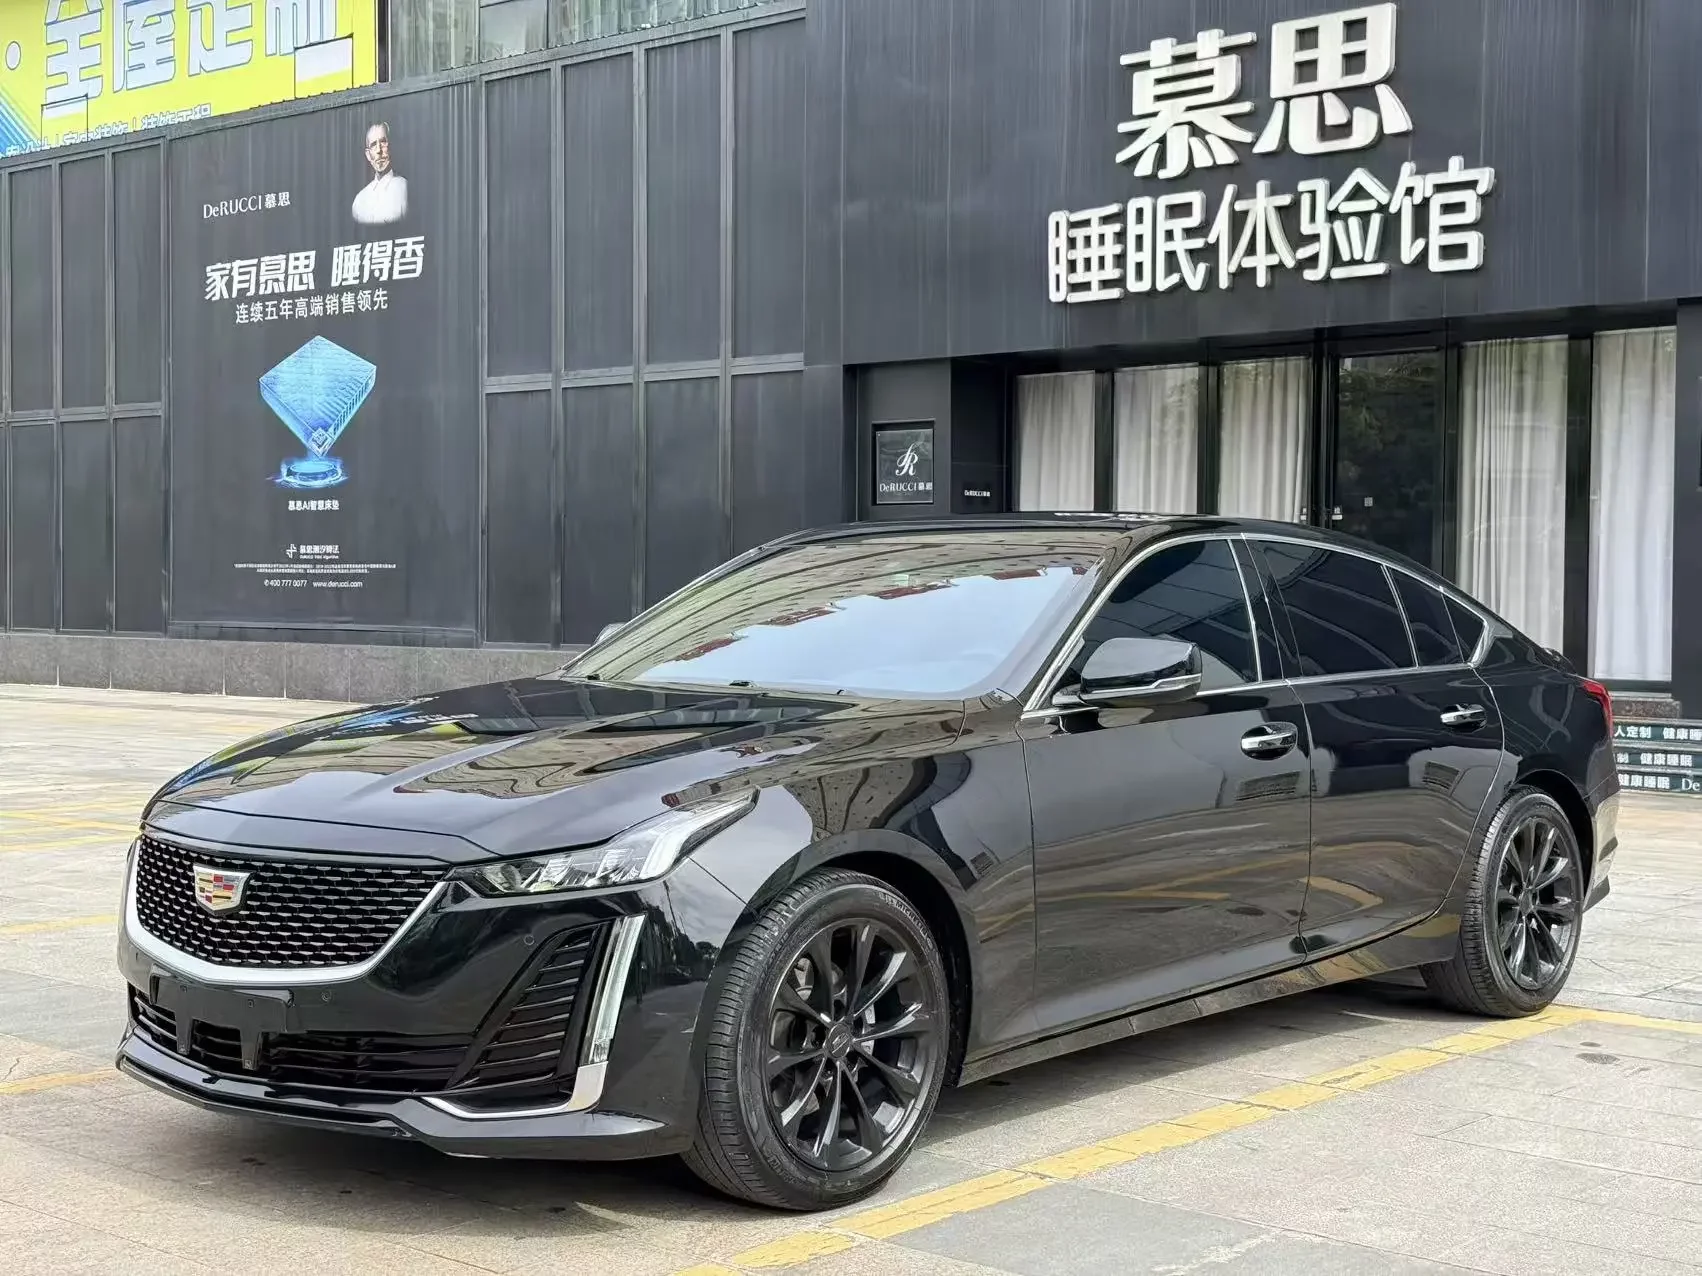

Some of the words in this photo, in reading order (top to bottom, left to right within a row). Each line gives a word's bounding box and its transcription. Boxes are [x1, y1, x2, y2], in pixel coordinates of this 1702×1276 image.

[1115, 3, 1412, 179] 慕思
[203, 194, 262, 219] DeRUCCI
[264, 191, 291, 209] 慕思
[1048, 156, 1494, 303] 睡眠体验馆
[204, 250, 317, 301] 家有慕思
[331, 235, 425, 288] 睡得香
[235, 288, 389, 324] 连续五年高端销售领先
[879, 482, 917, 493] DeRUCCI
[1681, 778, 1700, 790] De
